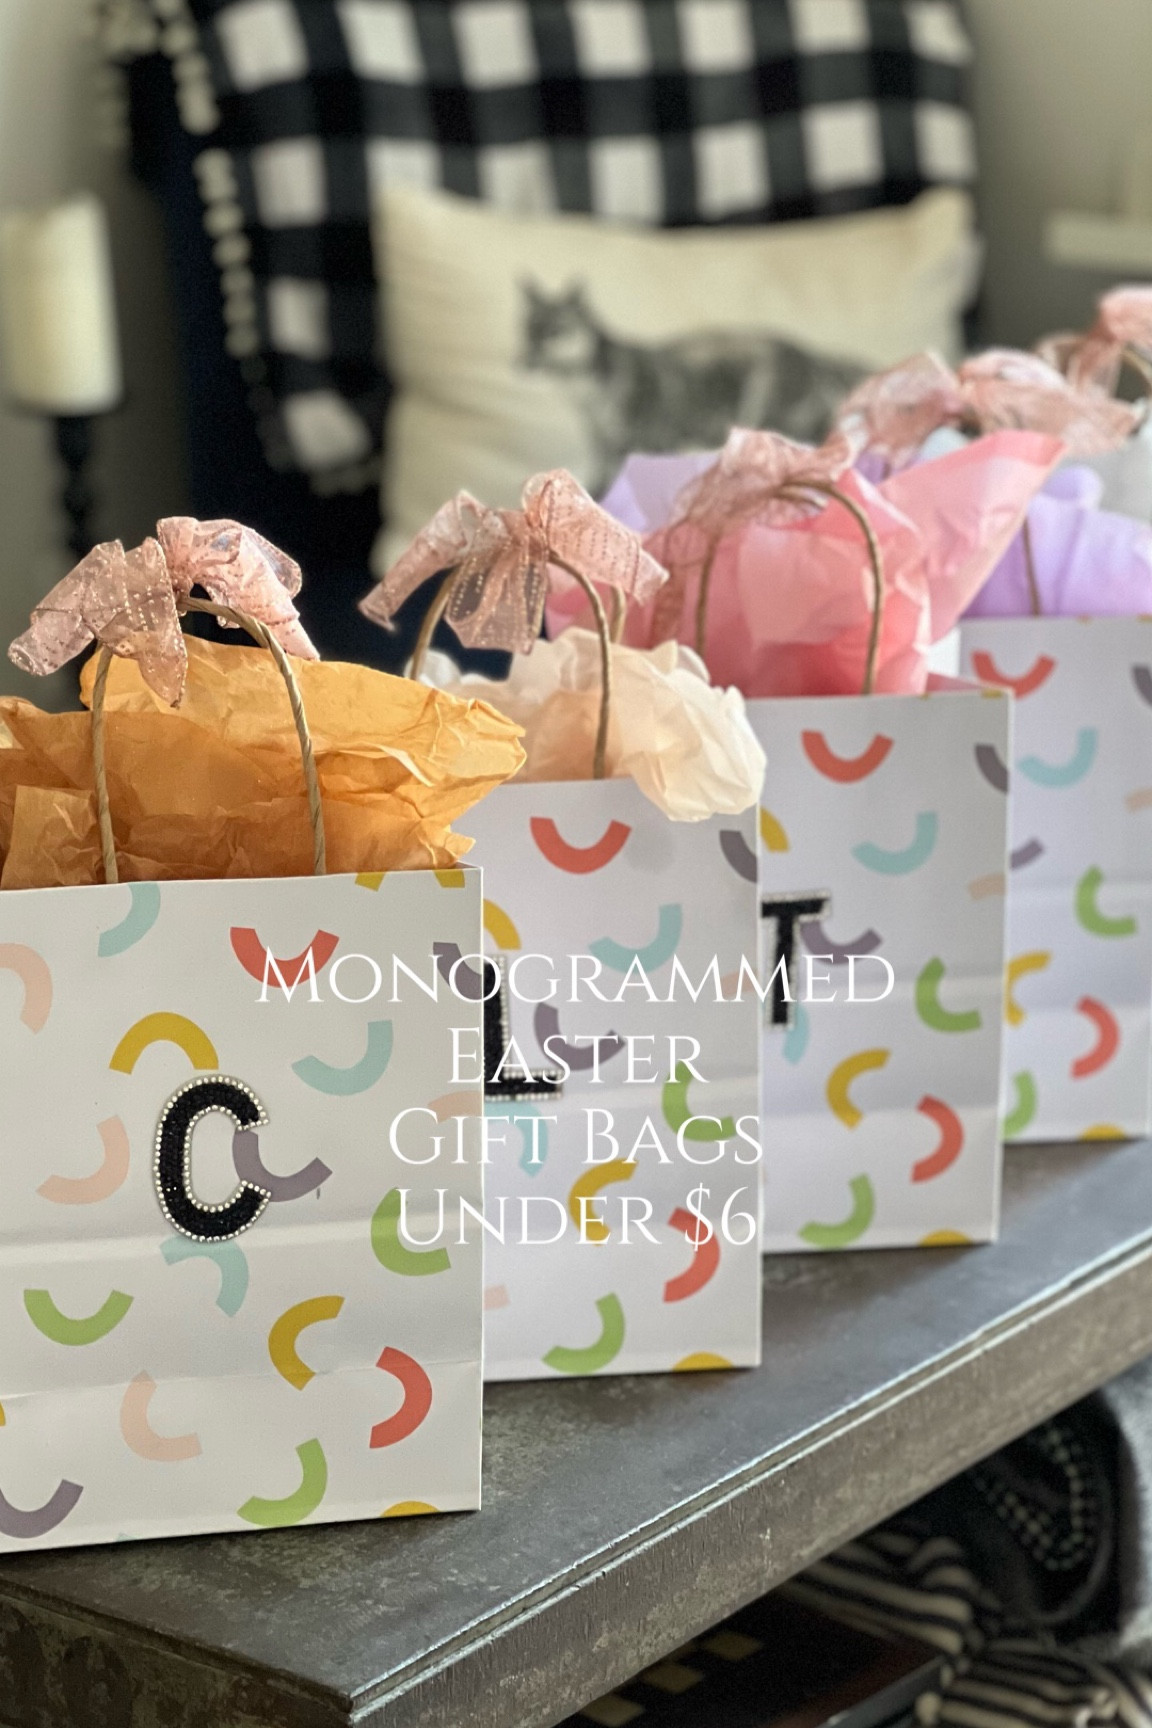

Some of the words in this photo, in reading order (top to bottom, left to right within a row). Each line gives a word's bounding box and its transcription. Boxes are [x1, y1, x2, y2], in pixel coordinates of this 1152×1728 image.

[484, 955, 564, 1101] L
[762, 889, 831, 1031] T
[153, 1075, 271, 1243] C
